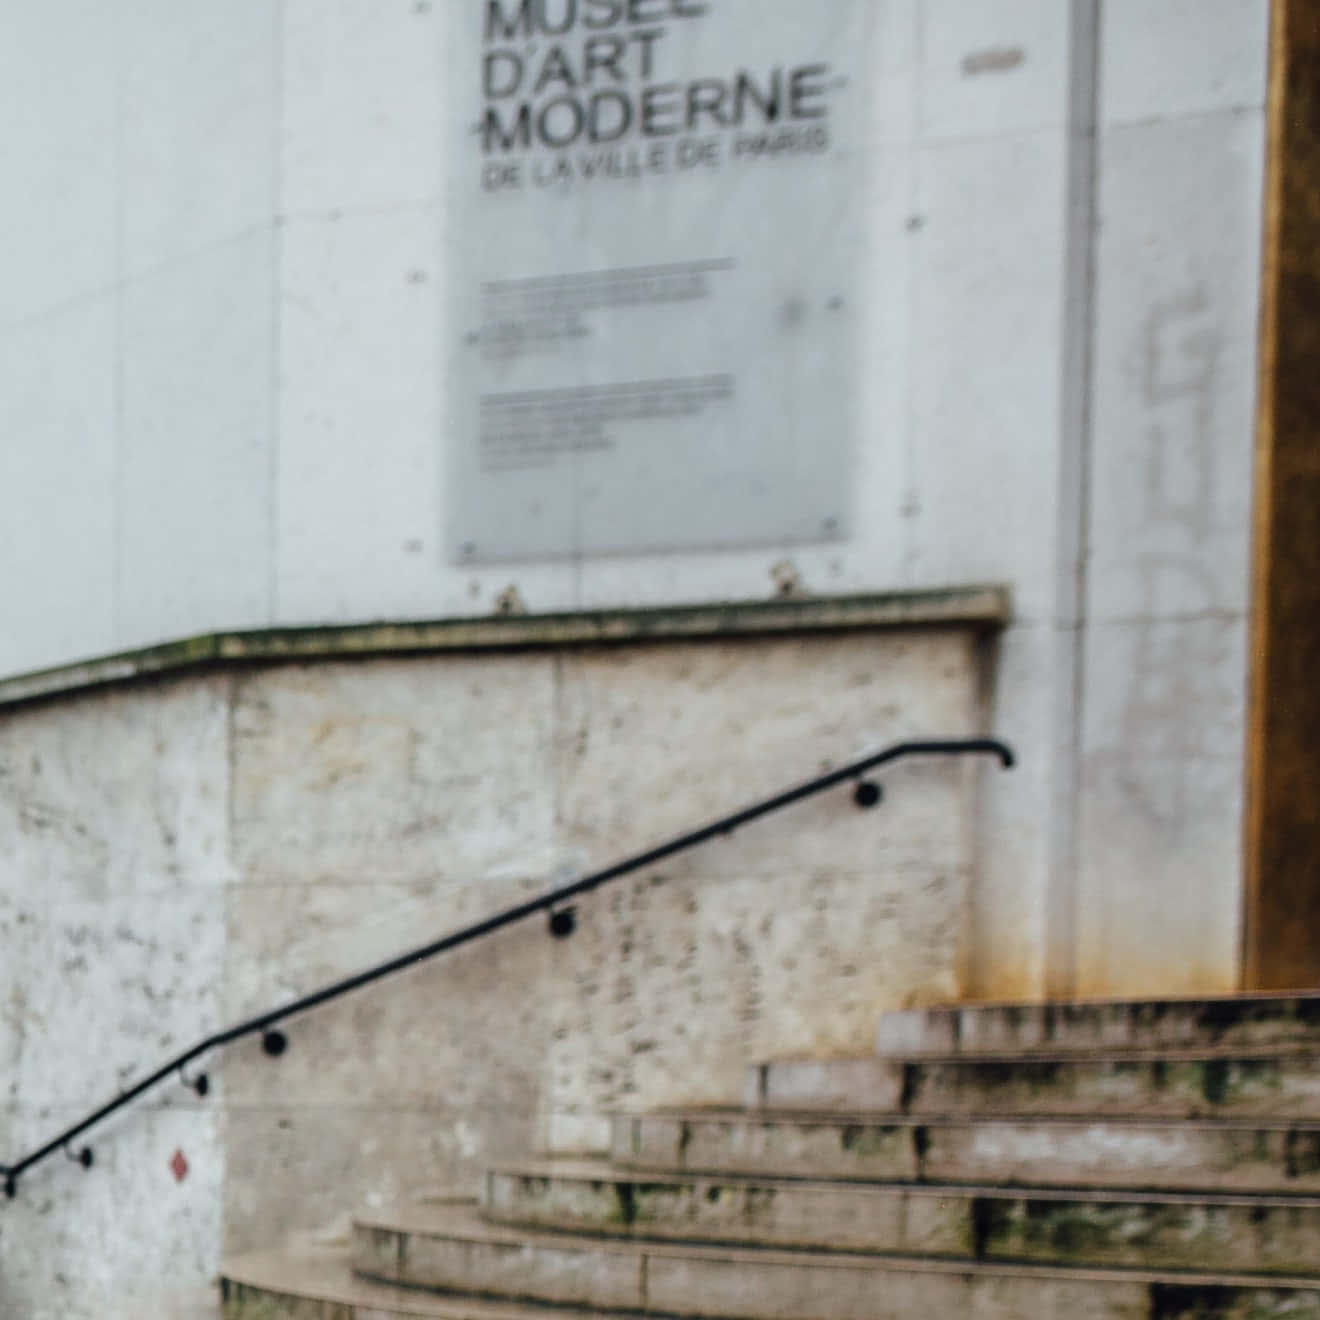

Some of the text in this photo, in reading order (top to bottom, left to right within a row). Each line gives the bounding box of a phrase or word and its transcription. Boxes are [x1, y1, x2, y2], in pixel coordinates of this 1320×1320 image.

[482, 29, 663, 102] D'ART
[481, 62, 830, 153] MODERNE
[578, 143, 664, 182] VILLE
[675, 138, 720, 170] DE
